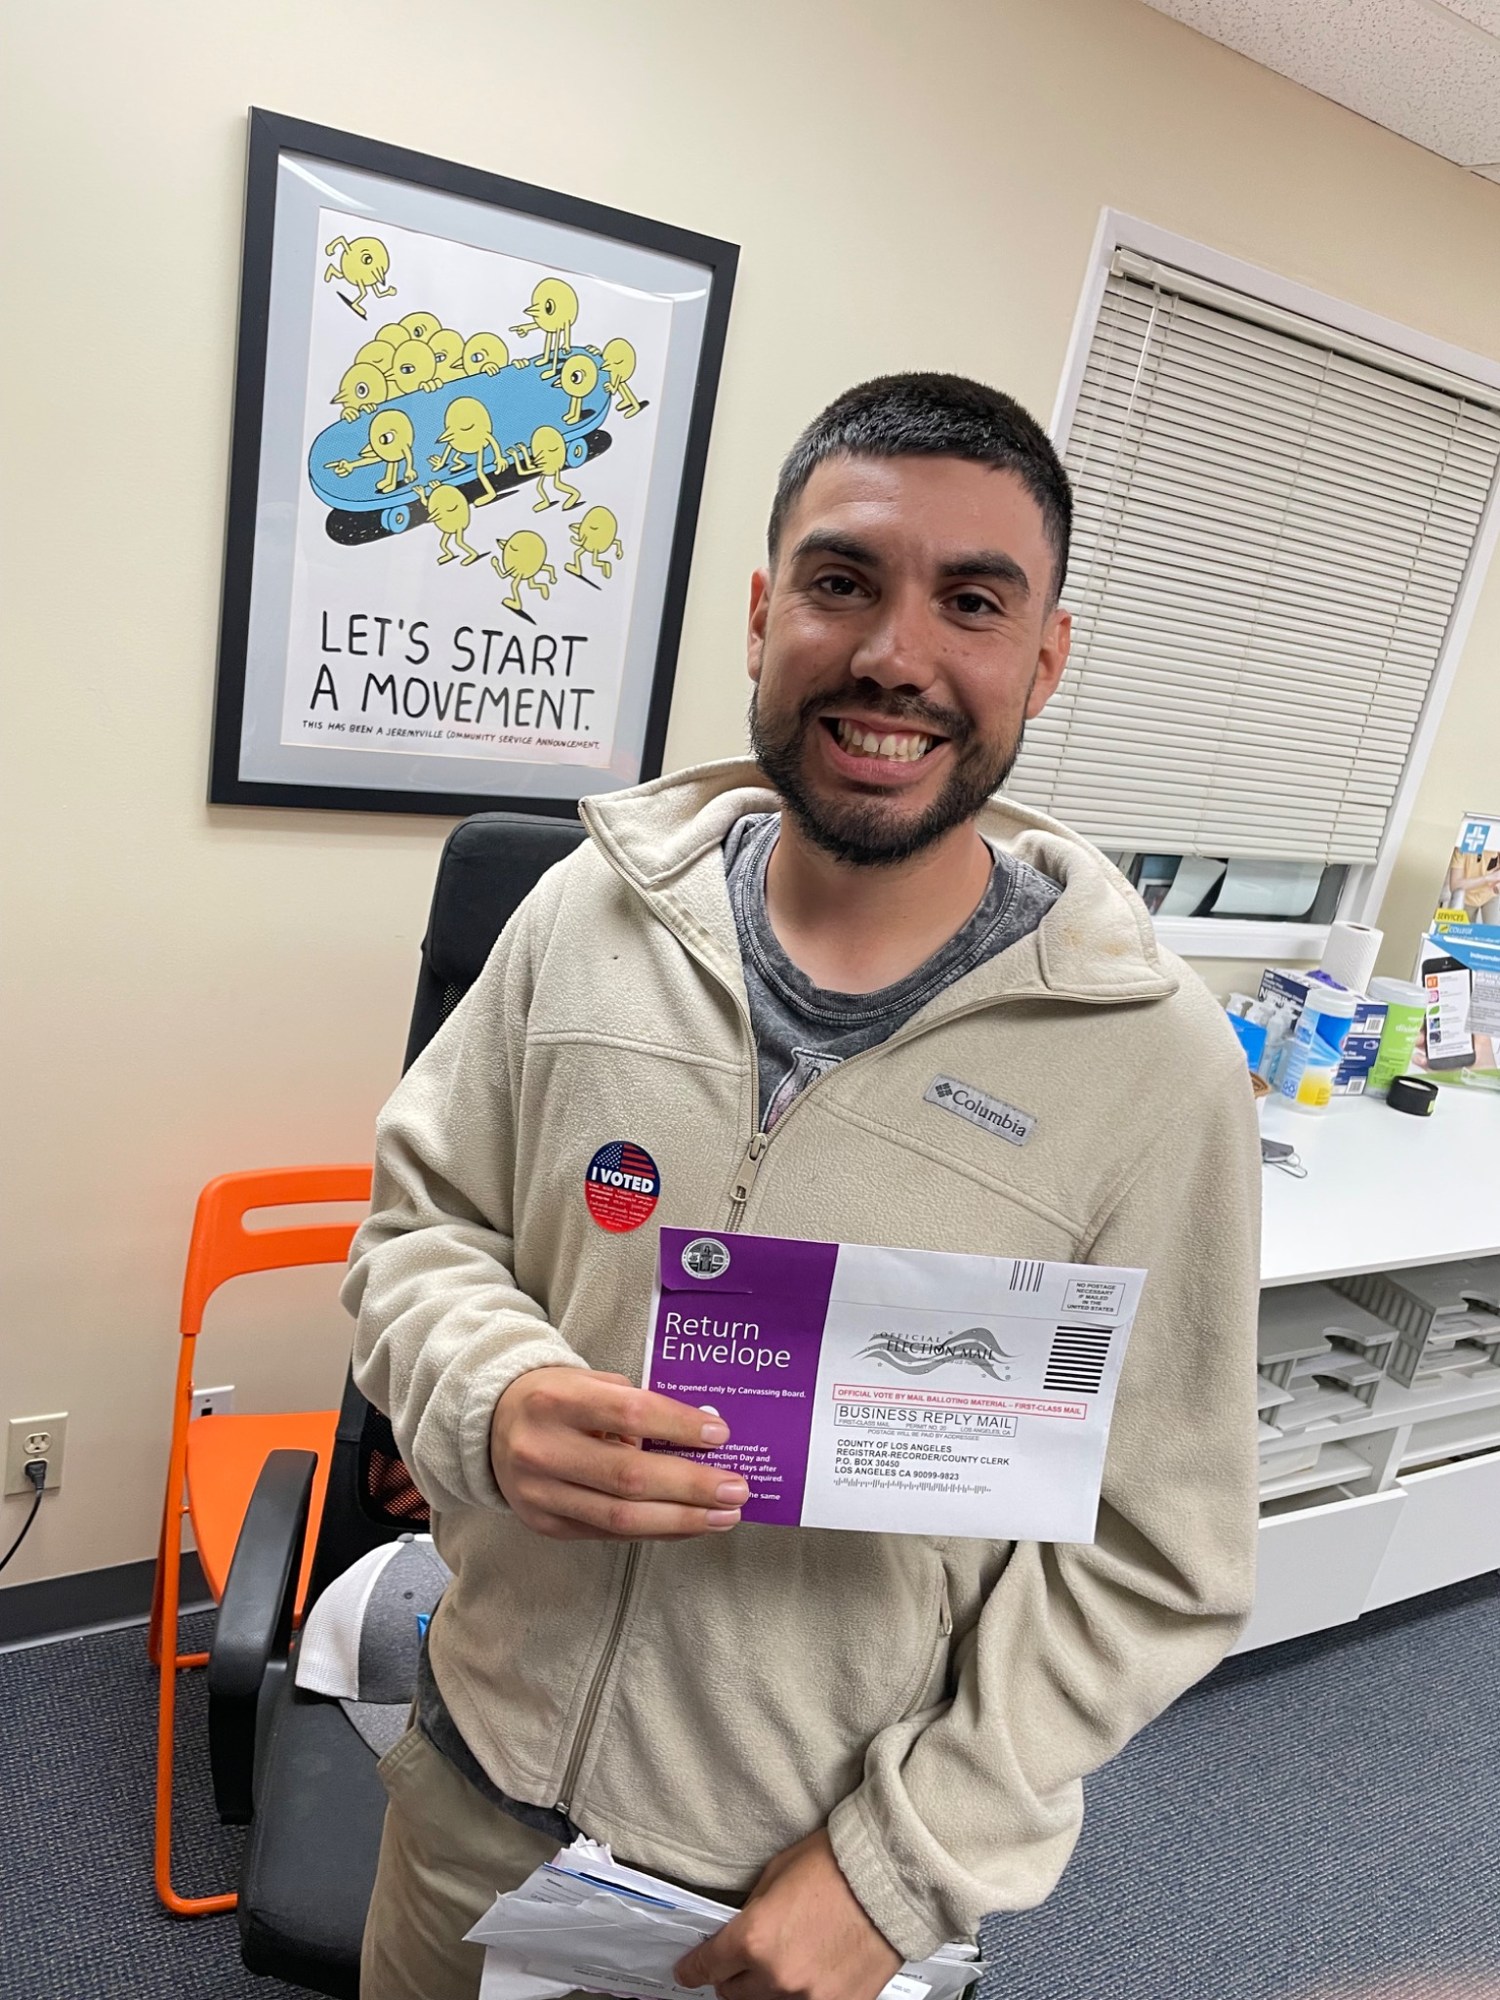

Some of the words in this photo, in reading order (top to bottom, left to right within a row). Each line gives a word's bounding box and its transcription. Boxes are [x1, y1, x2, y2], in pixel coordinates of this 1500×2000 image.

[321, 610, 430, 665] LET'S
[451, 626, 589, 677] START
[309, 663, 339, 711] A
[361, 672, 595, 731] MOVEMENT.
[302, 720, 323, 729] THIS
[328, 722, 346, 732] HAS
[349, 724, 374, 734] BEEN
[376, 727, 383, 735] A
[385, 727, 443, 739] JEREMYVILLE
[446, 730, 496, 742] COMMUNITY
[499, 735, 532, 745] SERVICE
[951, 1089, 1027, 1138] Columbia
[591, 1166, 598, 1181] I
[600, 1168, 654, 1193] VOTED
[665, 1312, 760, 1341] Return
[880, 1331, 941, 1343] OFFICIAL
[662, 1336, 791, 1372] Envelope
[886, 1339, 956, 1357] ELECTION
[959, 1347, 993, 1360] MAIL
[656, 1381, 666, 1390] To
[667, 1382, 677, 1391] be
[678, 1384, 707, 1393] opened
[709, 1385, 726, 1395] only
[726, 1386, 737, 1395] by
[738, 1387, 781, 1398] Canvassing
[781, 1389, 807, 1398] Board.
[838, 1389, 871, 1398] OFFICIAL
[874, 1391, 893, 1399] VOTE
[926, 1395, 969, 1405] BALLOTING
[970, 1399, 1006, 1408] MATERIAL
[1015, 1403, 1062, 1413] FIRST-CLASS
[1064, 1407, 1081, 1415] MAIL
[839, 1406, 917, 1422] BUSINESS
[923, 1411, 972, 1425] REPLY
[977, 1415, 1012, 1429] MAIL
[725, 1444, 759, 1452] returned
[837, 1439, 874, 1448] COUNTY
[891, 1442, 908, 1450] LOS
[910, 1444, 952, 1453] ANGELES
[696, 1452, 706, 1461] by
[707, 1452, 738, 1460] Election
[740, 1454, 754, 1463] Day
[836, 1448, 978, 1463] REGISTRAR-RECORDER/COUNTY
[980, 1456, 1010, 1466] CLERK
[836, 1457, 852, 1465] P.O.
[854, 1458, 873, 1466] BOX
[875, 1460, 900, 1468] 30450
[740, 1464, 757, 1472] days
[834, 1466, 853, 1474] LOS
[854, 1468, 897, 1477] ANGELES
